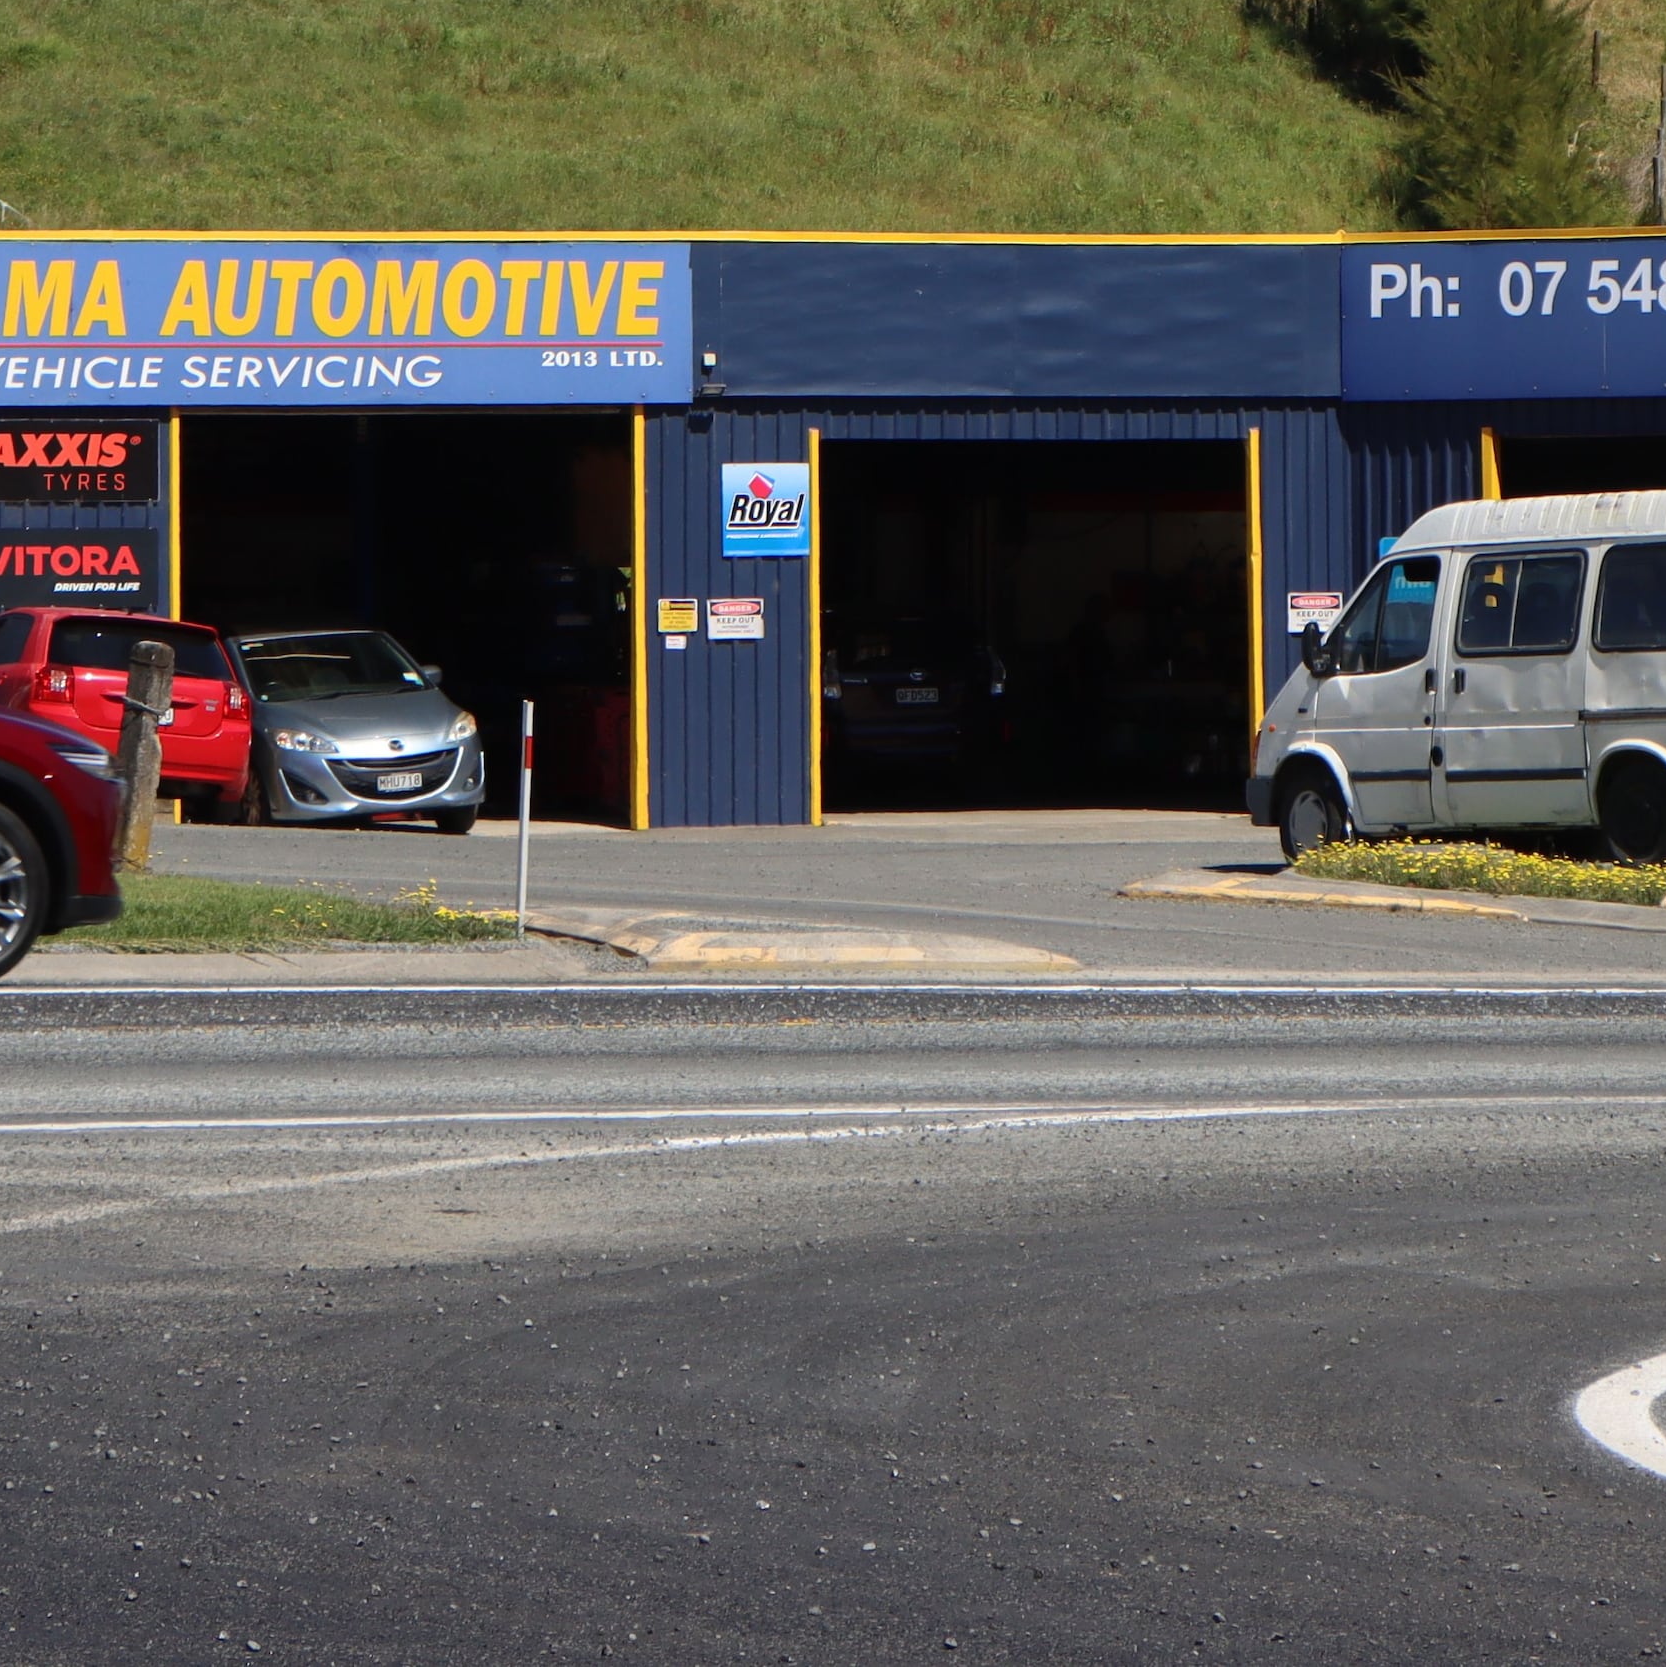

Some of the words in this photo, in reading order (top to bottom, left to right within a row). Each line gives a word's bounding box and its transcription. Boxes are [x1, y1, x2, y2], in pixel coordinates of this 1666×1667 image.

[161, 259, 664, 337] AUTOMOTIVE
[1370, 263, 1460, 319] Ph:
[1499, 261, 1567, 316] 07
[541, 350, 598, 367] 2013
[609, 350, 664, 367] LTD.
[180, 355, 443, 389] SERVICING
[43, 474, 126, 491] TYRES
[729, 493, 806, 528] Royal
[53, 583, 93, 592] DRIVEN
[94, 583, 116, 592] FOR
[117, 583, 141, 592] LIFE
[1298, 598, 1332, 606] DANGER
[738, 616, 755, 624] OUT
[379, 774, 421, 788] MHU718
